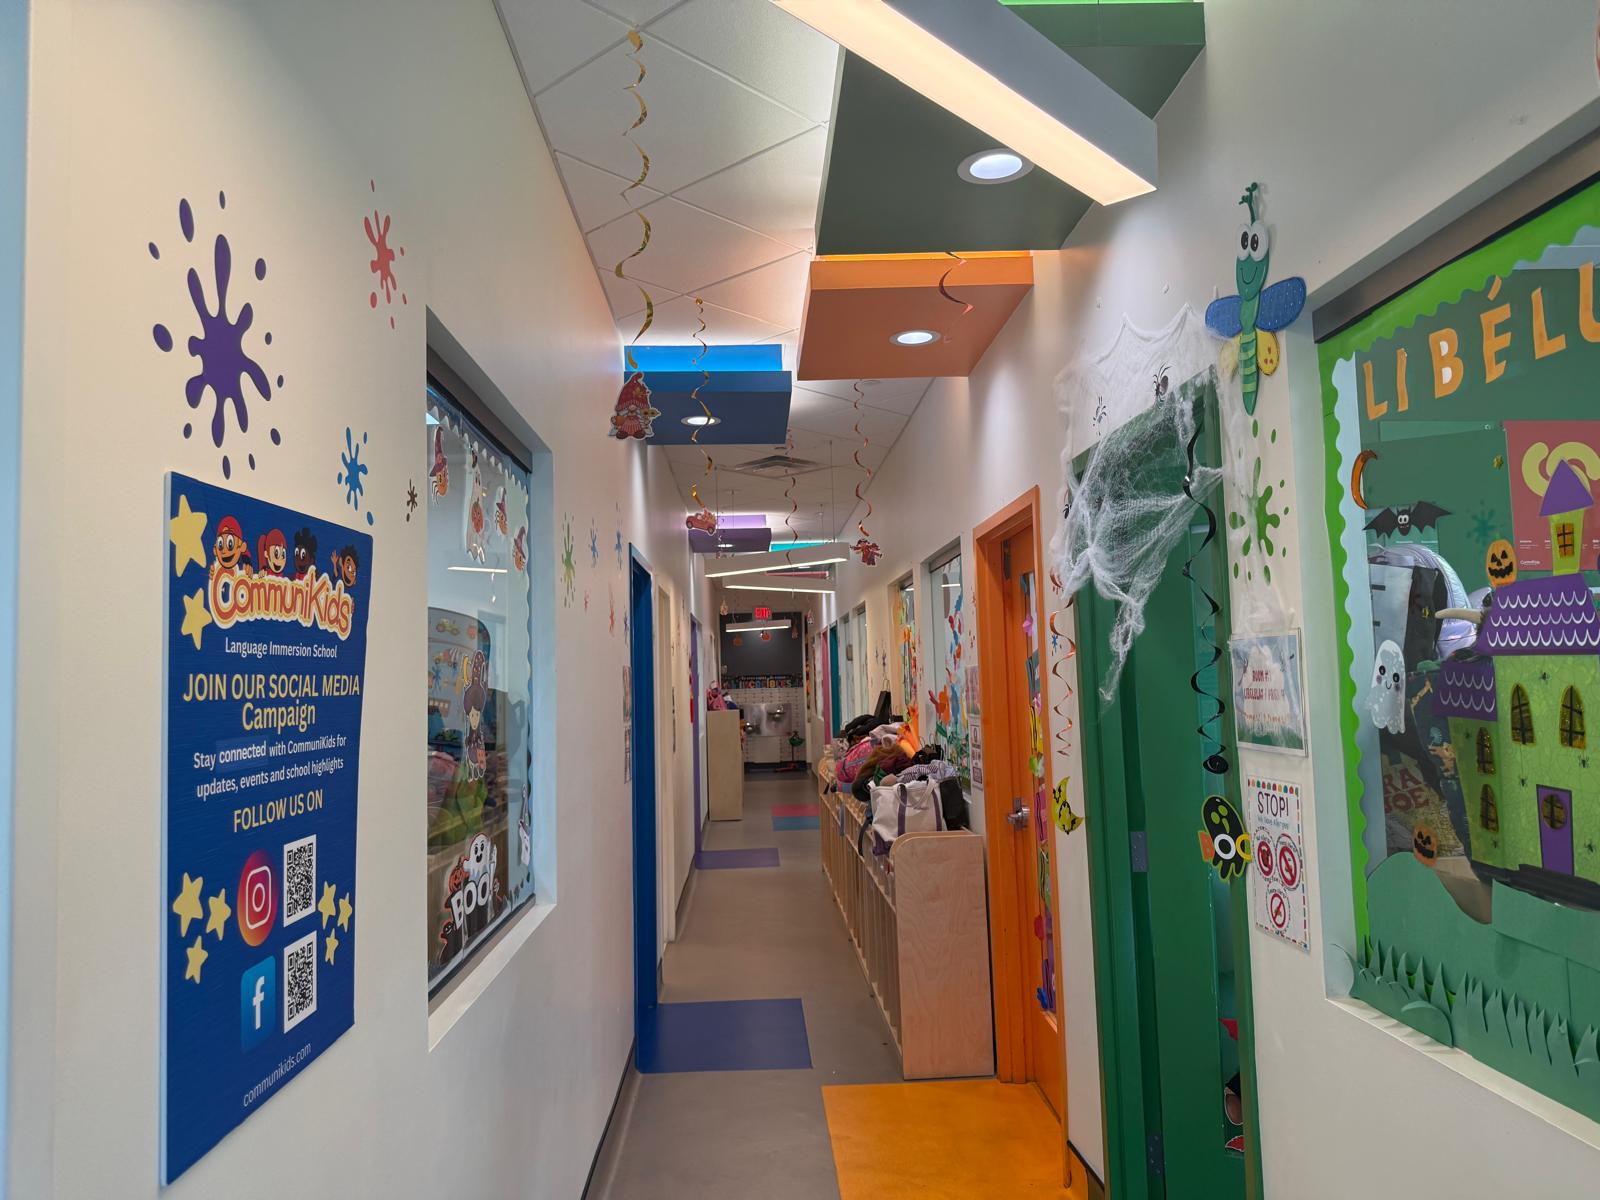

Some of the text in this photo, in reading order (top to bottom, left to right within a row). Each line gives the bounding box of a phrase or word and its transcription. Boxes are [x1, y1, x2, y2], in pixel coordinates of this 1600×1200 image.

[211, 564, 351, 637] CommuniKids
[225, 637, 338, 658] Language Immersion School
[183, 673, 360, 702] JOIN OUR SOCIAL MEDIA
[242, 699, 316, 734] Campaign
[193, 734, 347, 771] Stay connected with CommuniKids for
[196, 757, 344, 802] updates, events and school highlights
[233, 789, 323, 833] FOLLOW US ON
[243, 1042, 312, 1108] communikids.com
